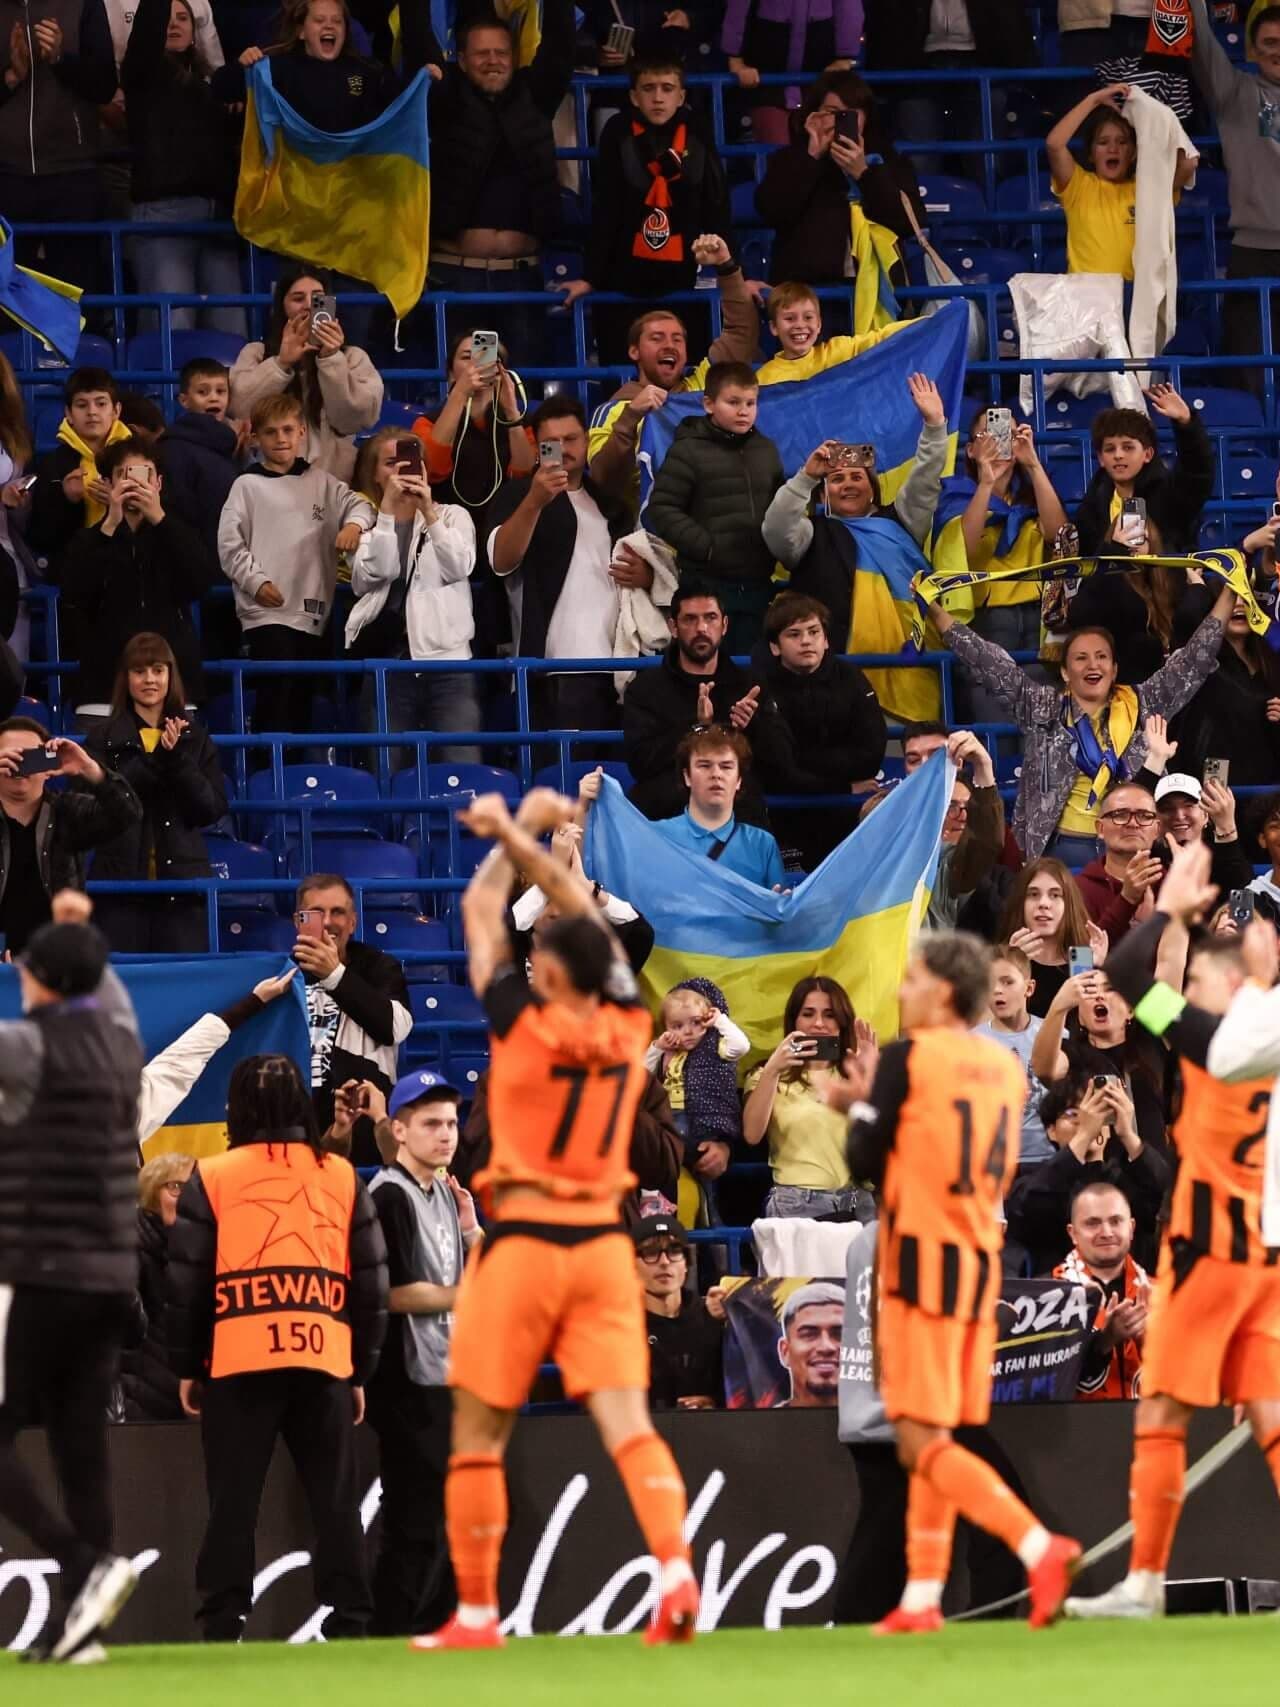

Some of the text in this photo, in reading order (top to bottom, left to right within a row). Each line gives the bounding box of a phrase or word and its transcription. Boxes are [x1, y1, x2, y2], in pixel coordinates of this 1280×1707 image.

[548, 1062, 630, 1158] 77
[949, 1098, 1009, 1197] 14
[215, 1272, 345, 1314] STEWAD
[1010, 1286, 1089, 1334] OZA
[267, 1322, 324, 1354] 150
[839, 1364, 873, 1382] LEAG
[989, 1361, 1003, 1377] AR
[1005, 1356, 1026, 1374] FAN
[1028, 1354, 1041, 1369] IN
